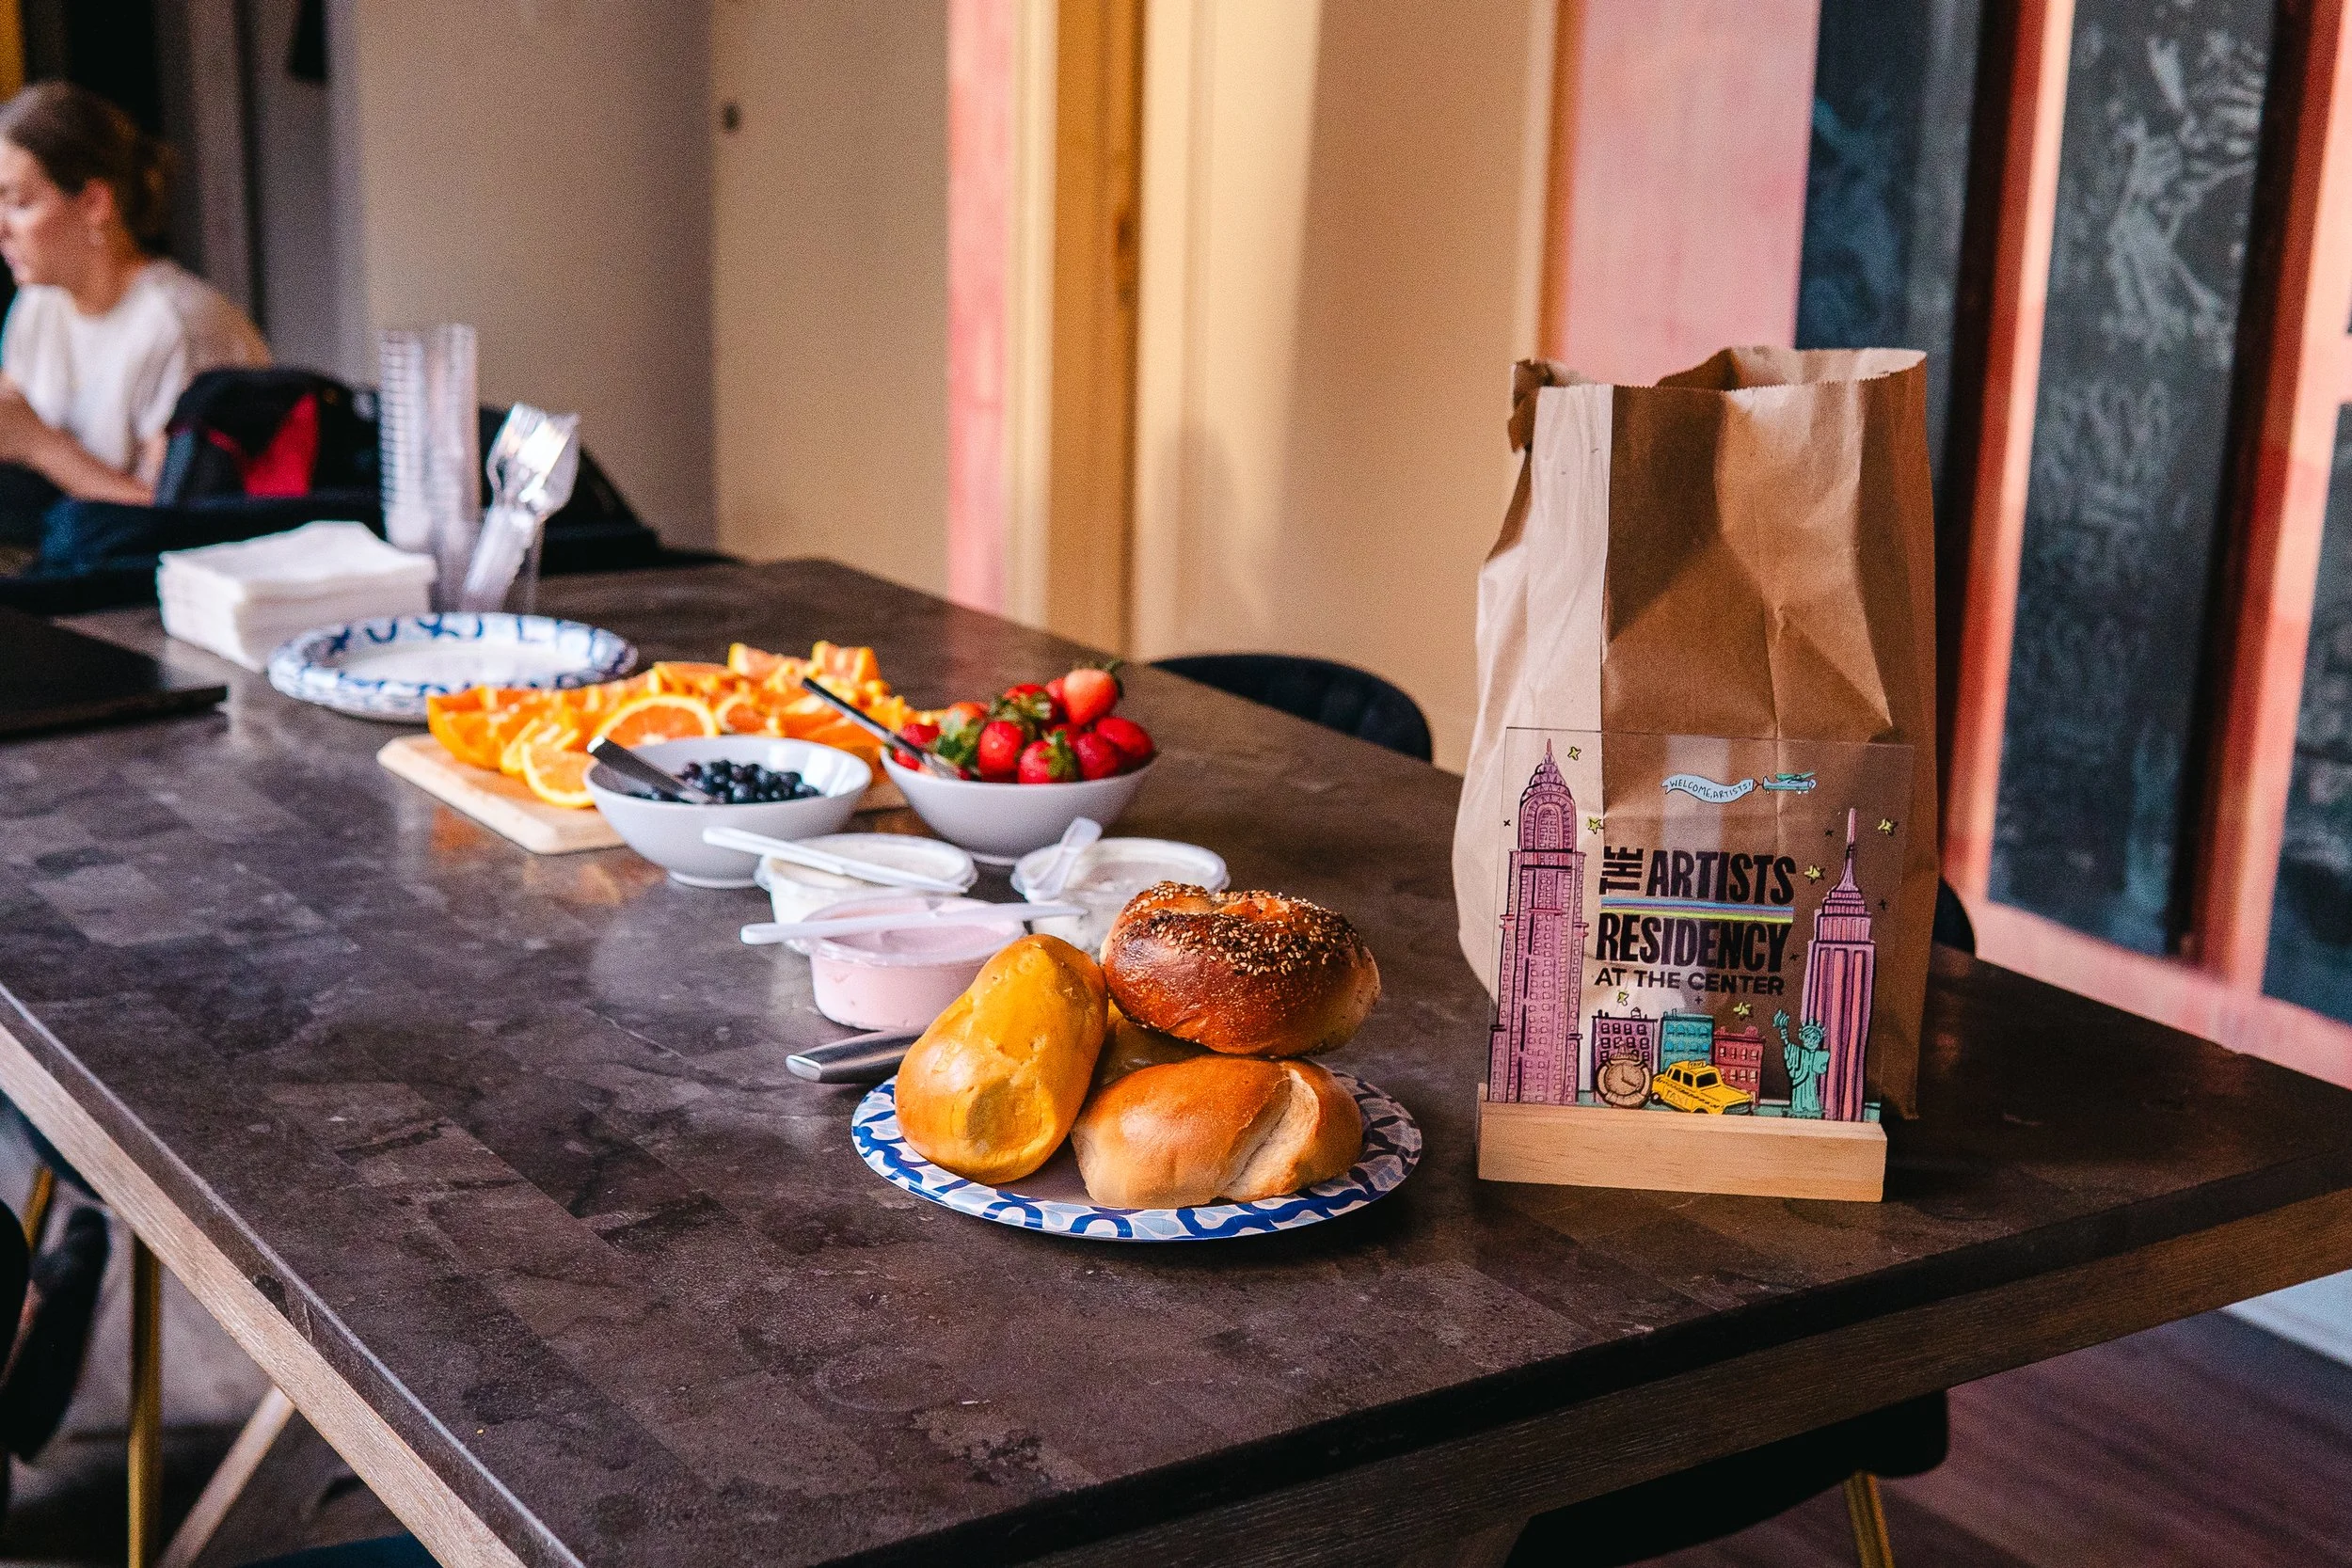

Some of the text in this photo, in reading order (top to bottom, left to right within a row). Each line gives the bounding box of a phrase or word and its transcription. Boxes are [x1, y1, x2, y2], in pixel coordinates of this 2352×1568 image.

[1599, 846, 1797, 905] THE ARTISTS
[1596, 912, 1793, 973] RESIDENCY
[1595, 968, 1785, 995] AT THE CENTER
